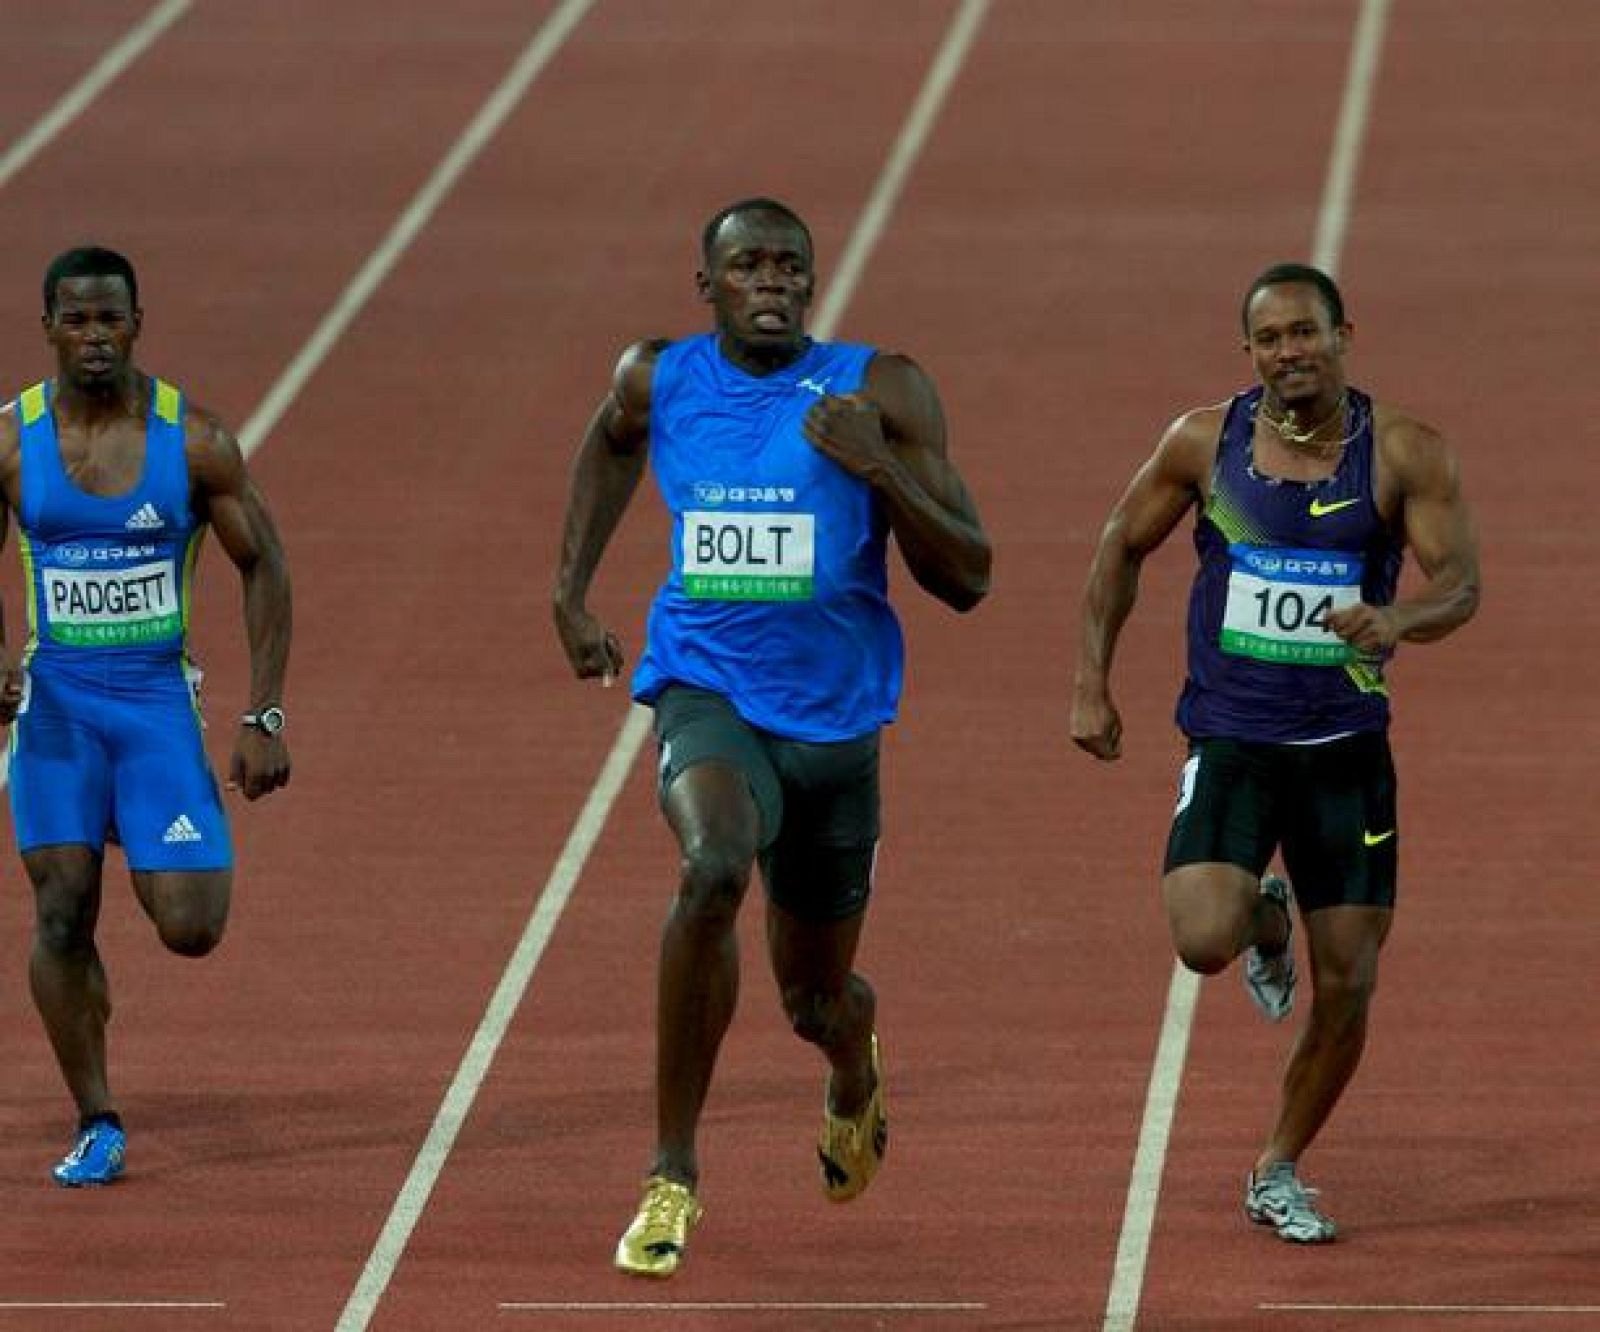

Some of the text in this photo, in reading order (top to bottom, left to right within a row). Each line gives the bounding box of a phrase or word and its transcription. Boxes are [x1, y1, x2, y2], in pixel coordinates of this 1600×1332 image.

[696, 525, 793, 565] BOLT
[52, 571, 165, 614] PADGETT
[1254, 587, 1335, 632] 104
